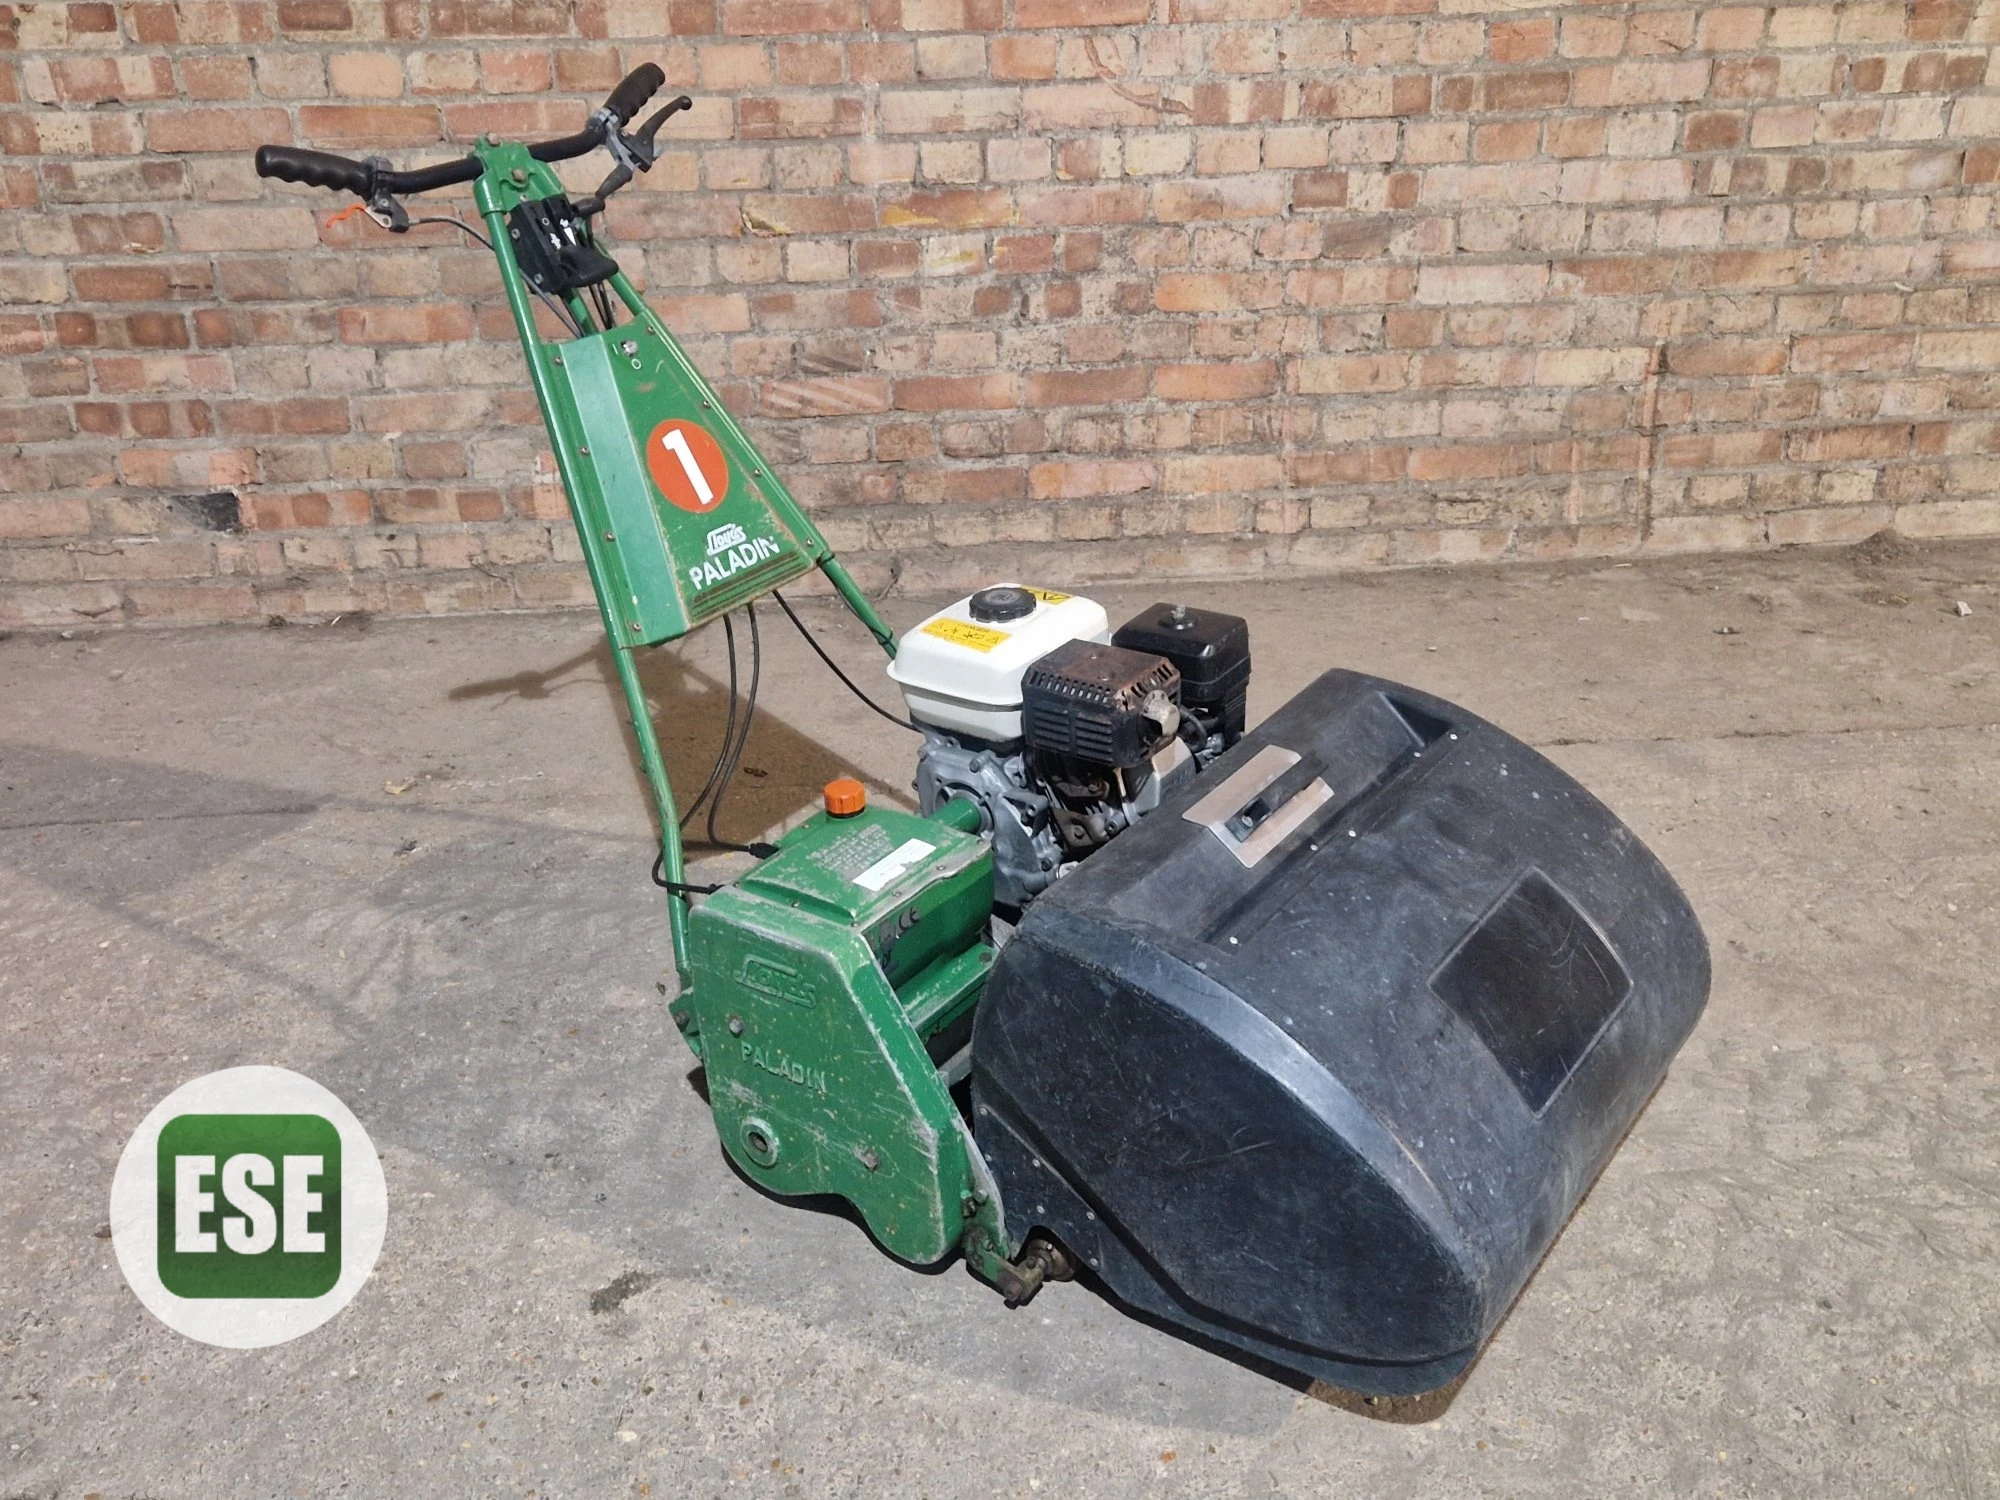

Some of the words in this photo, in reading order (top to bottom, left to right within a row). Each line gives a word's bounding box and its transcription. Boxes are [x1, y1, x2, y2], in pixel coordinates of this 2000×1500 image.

[661, 428, 714, 505] 1
[689, 536, 780, 590] PALADIN
[741, 1041, 827, 1093] PALADIN
